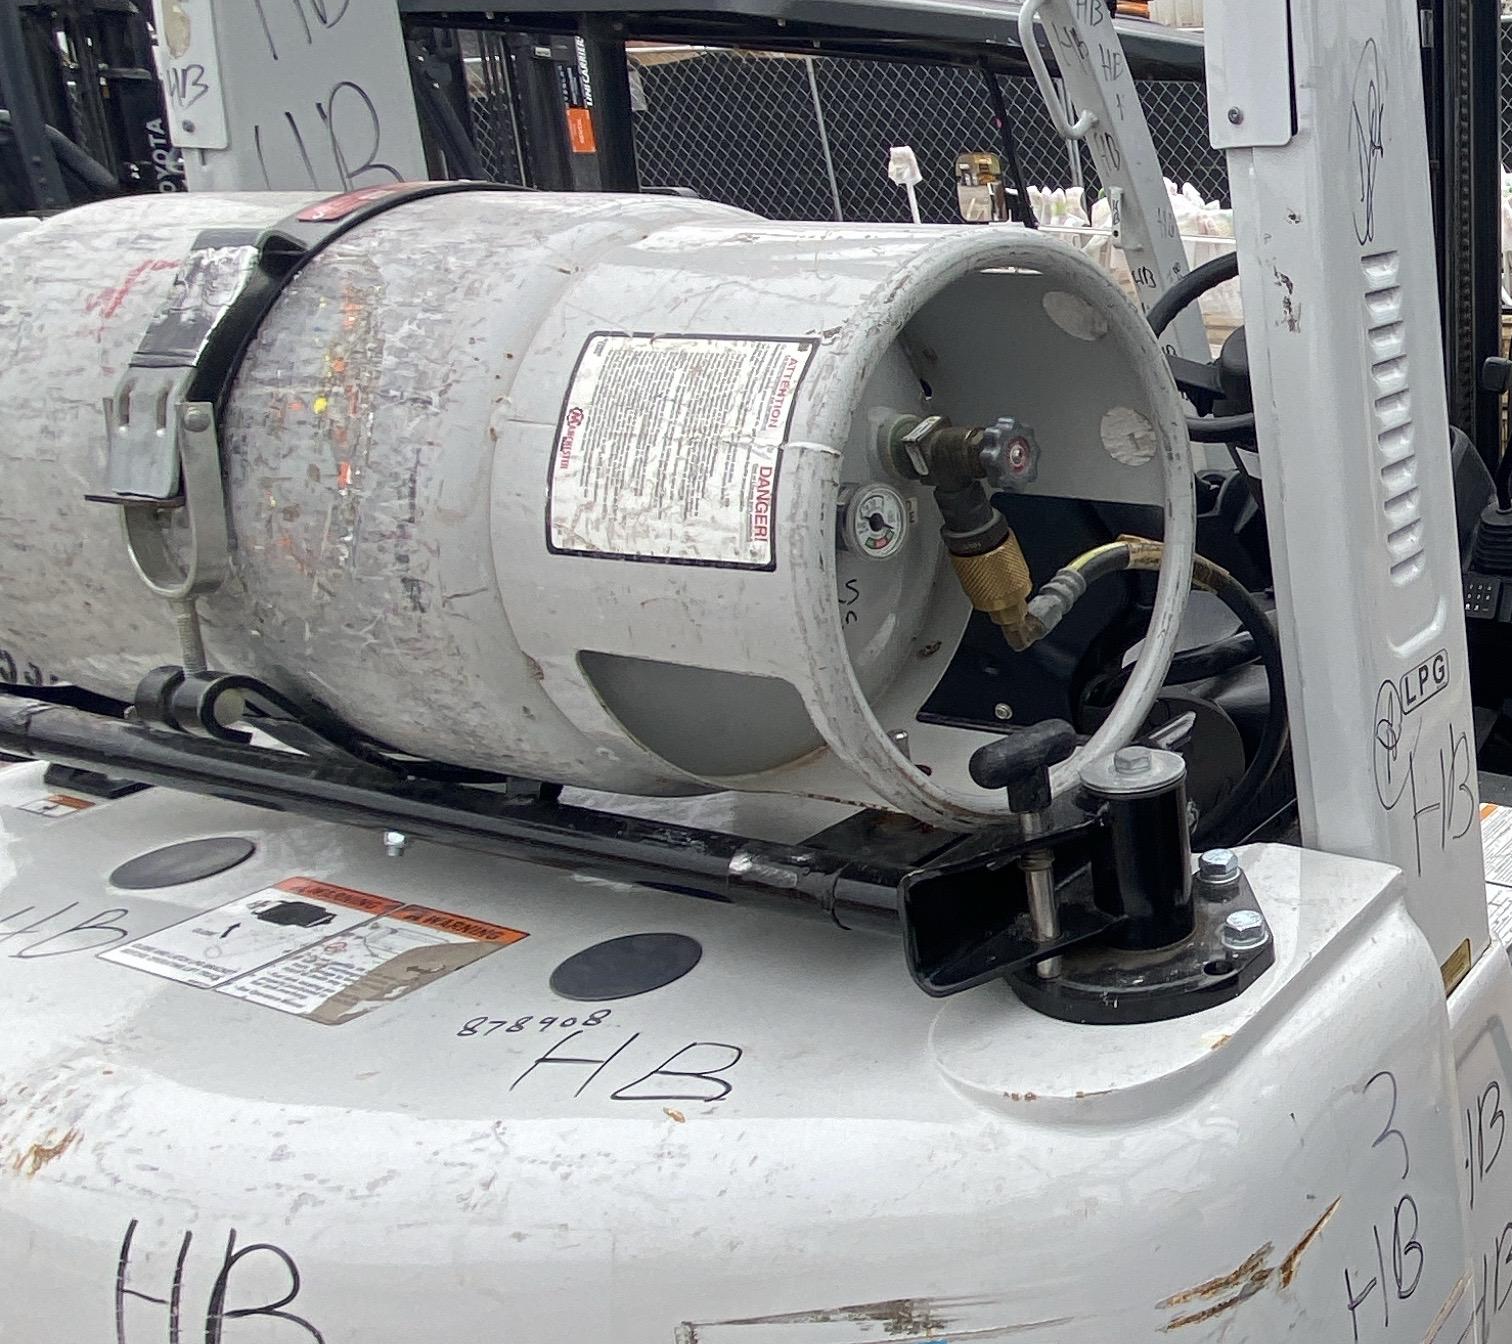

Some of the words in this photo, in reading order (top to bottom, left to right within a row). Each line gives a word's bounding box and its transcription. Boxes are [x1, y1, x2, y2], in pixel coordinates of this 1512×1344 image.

[146, 118, 183, 192] OYOTA
[1405, 655, 1446, 706] LPG
[511, 1031, 743, 1103] HB
